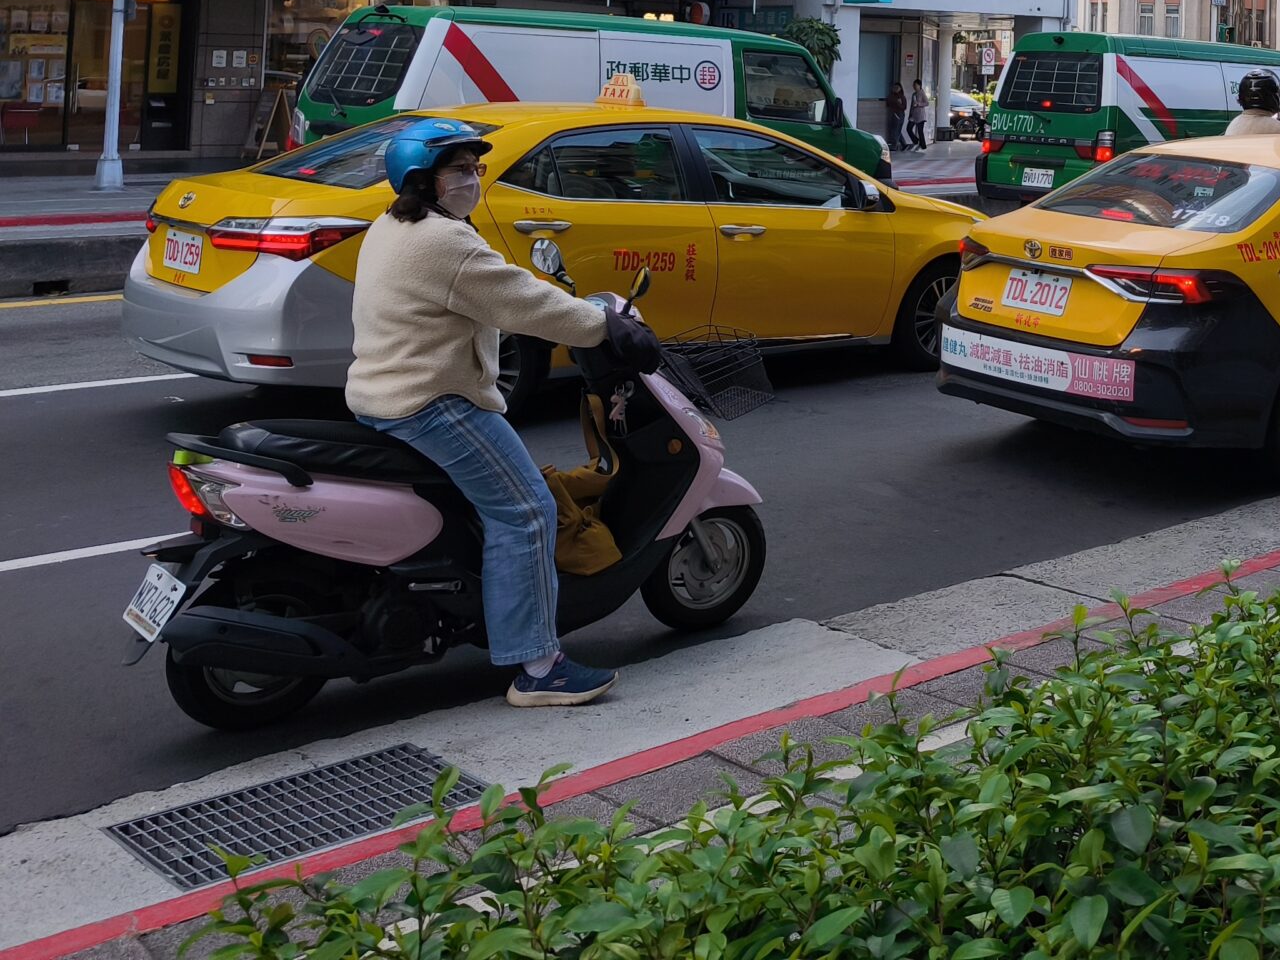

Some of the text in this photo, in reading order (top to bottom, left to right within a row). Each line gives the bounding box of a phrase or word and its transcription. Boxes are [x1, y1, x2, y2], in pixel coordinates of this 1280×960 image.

[603, 87, 631, 99] TAXI
[991, 113, 1034, 133] BVU-1770
[1171, 208, 1231, 227] 17218
[165, 237, 201, 267] TDD-1259
[613, 250, 676, 273] TDD-1259
[1006, 276, 1068, 310] TDL-2012
[970, 342, 1069, 379] 減肥減重、祛油消脂
[1073, 358, 1131, 386] 仙桃牌
[1073, 380, 1130, 398] 0800-302020
